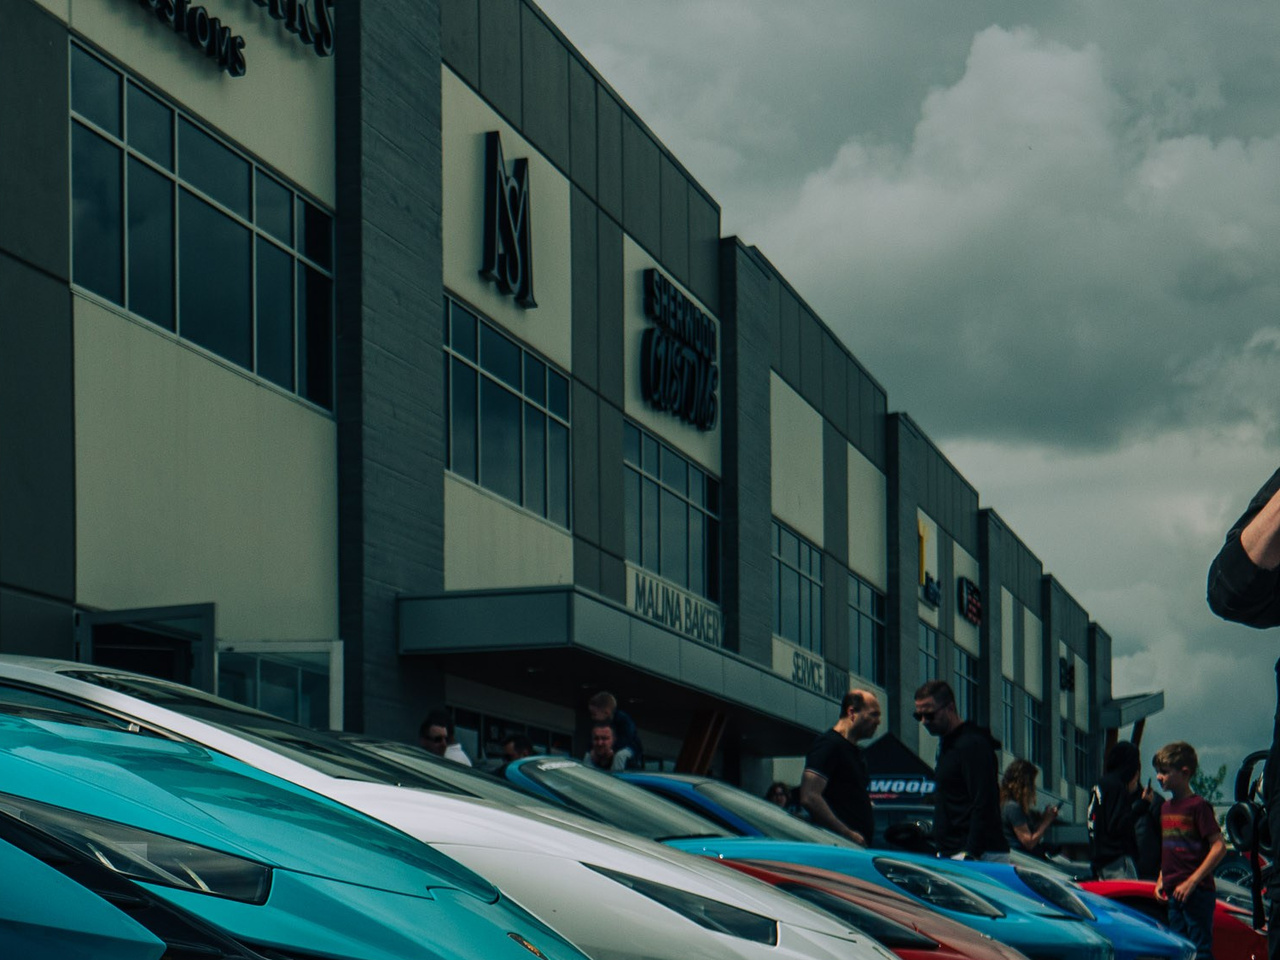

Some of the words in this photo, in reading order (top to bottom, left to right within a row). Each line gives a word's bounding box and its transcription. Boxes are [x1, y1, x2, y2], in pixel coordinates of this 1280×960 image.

[634, 572, 683, 632] MALINA
[684, 596, 726, 648] BAKER
[792, 651, 823, 692] SERVICE
